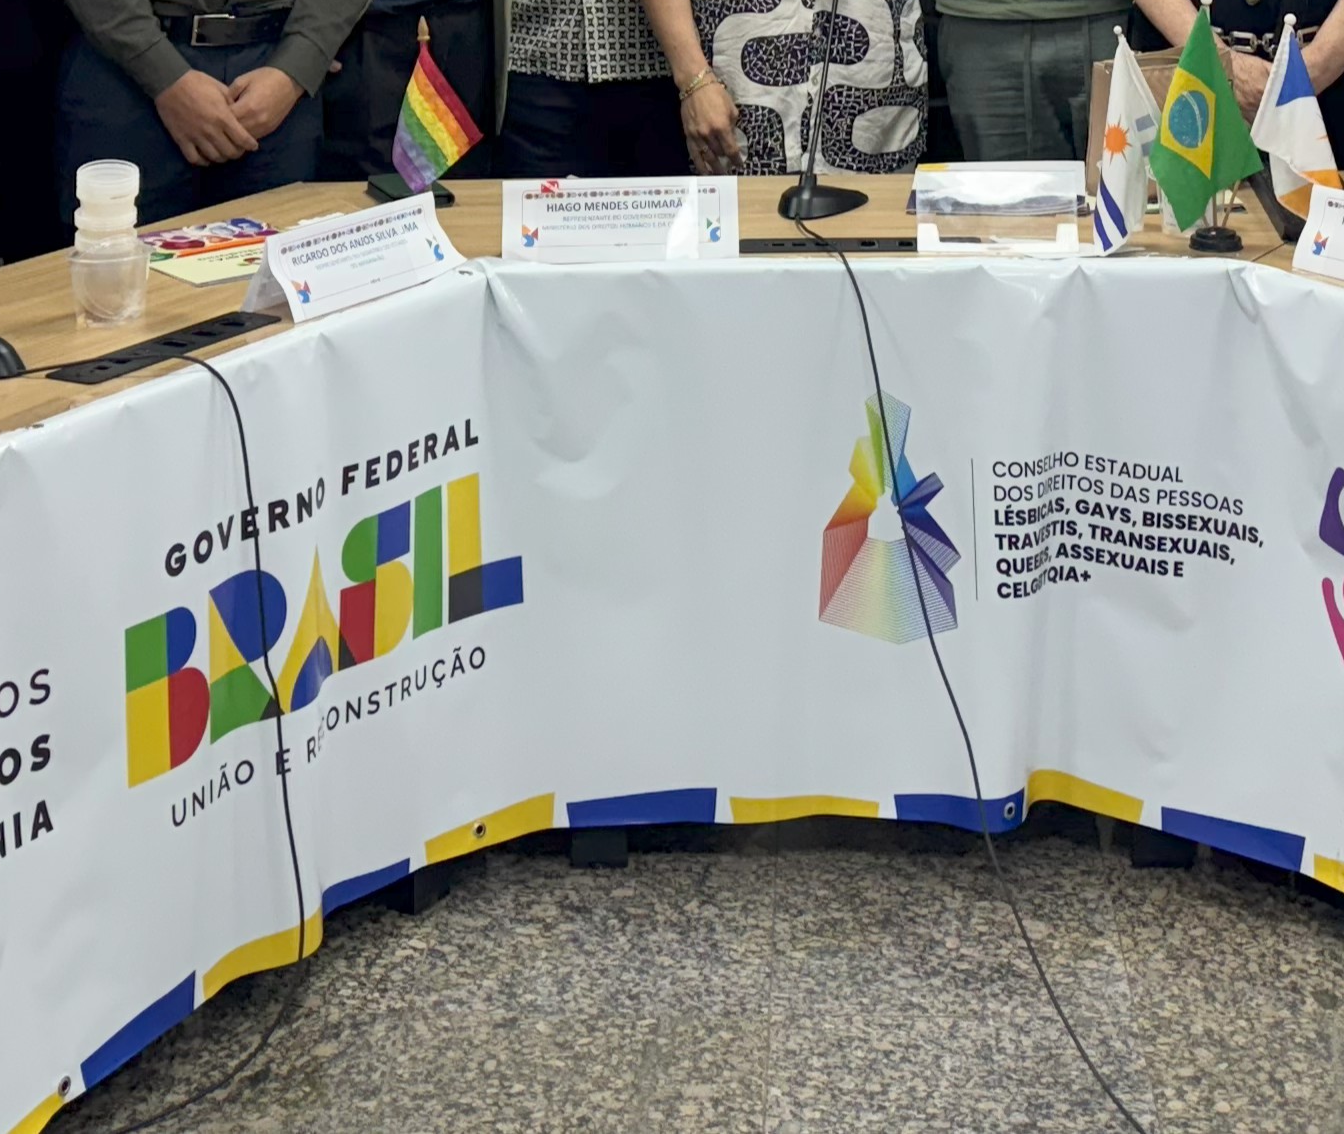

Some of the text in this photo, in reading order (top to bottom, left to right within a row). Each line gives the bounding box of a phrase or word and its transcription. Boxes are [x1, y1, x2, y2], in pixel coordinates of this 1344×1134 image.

[546, 197, 684, 212] HIAGO MENDES GUIMARÃ
[291, 247, 329, 267] RICARDO
[331, 242, 348, 255] DOS
[349, 235, 375, 249] ANJOS
[375, 228, 398, 243] SILVA
[992, 451, 1184, 484] CONSELHO ESTADUAL
[164, 419, 479, 578] GOVERNO FEDERAL
[994, 474, 1244, 516] DOS DIREITOS DAS PESSOAS
[994, 497, 1264, 548] LÉSBICAS, GAYS, BISSEXUAIS,
[994, 520, 1236, 565] TRAVESTIS, TRANSEXUAIS,
[1055, 542, 1169, 576] ASSEXUAIS
[1174, 562, 1184, 577] E
[124, 472, 524, 789] BRASIL
[170, 646, 486, 827] UNIÃO E RONSTRUÇÃO
